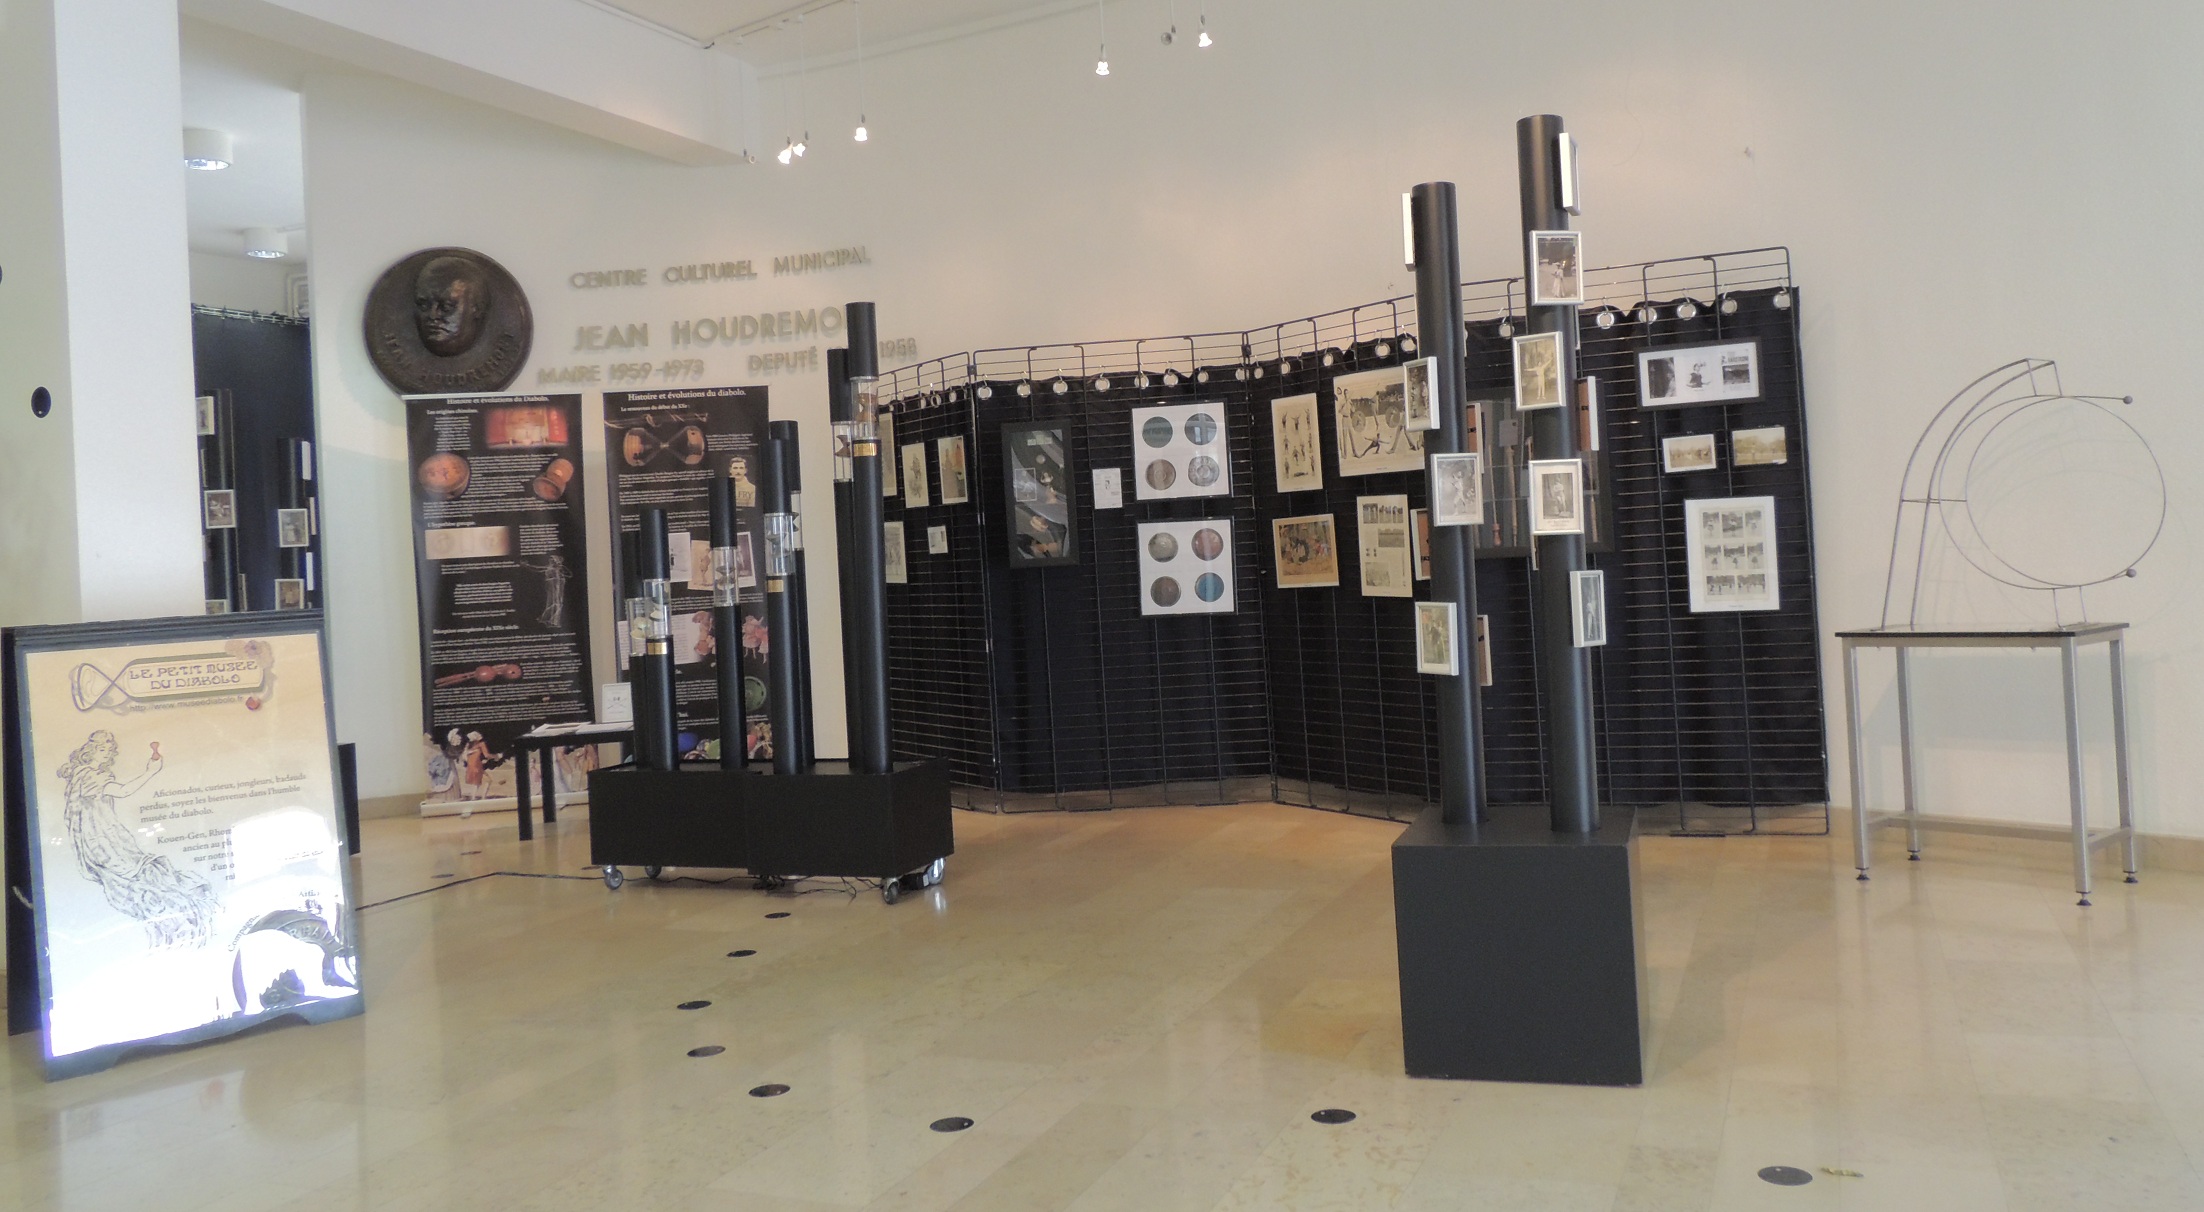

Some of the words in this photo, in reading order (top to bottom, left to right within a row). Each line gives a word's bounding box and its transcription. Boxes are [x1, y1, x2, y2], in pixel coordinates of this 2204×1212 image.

[570, 268, 647, 289] CENTRE
[663, 259, 758, 283] CULTUREL
[773, 246, 871, 275] MUNICIPAL
[574, 323, 649, 351] JEAN
[673, 306, 847, 346] HOUDREMO
[538, 365, 601, 384] MAIRE
[628, 393, 657, 401] Histoire
[667, 390, 705, 399] évolutions
[707, 389, 717, 397] du
[718, 388, 746, 397] diabolo.
[738, 491, 753, 500] FRY
[129, 668, 153, 680] LE
[157, 665, 203, 678] PETIT
[206, 660, 258, 674] MUSEE
[151, 679, 171, 690] DU
[175, 673, 241, 688] DIABOLO
[153, 786, 203, 798] Aficionados,
[205, 782, 236, 792] curieux,
[236, 778, 274, 790] jongleurs,
[140, 802, 170, 814] perdus,
[171, 799, 193, 808] soyez
[195, 796, 206, 805] les
[207, 792, 247, 803] bienvenus
[249, 789, 267, 798] dans
[268, 784, 301, 796] l'humble
[140, 813, 167, 823] musée
[169, 811, 180, 820] du
[181, 807, 214, 818] diabolo.
[157, 831, 207, 845] Kouen-Gen,
[183, 843, 209, 852] ancien
